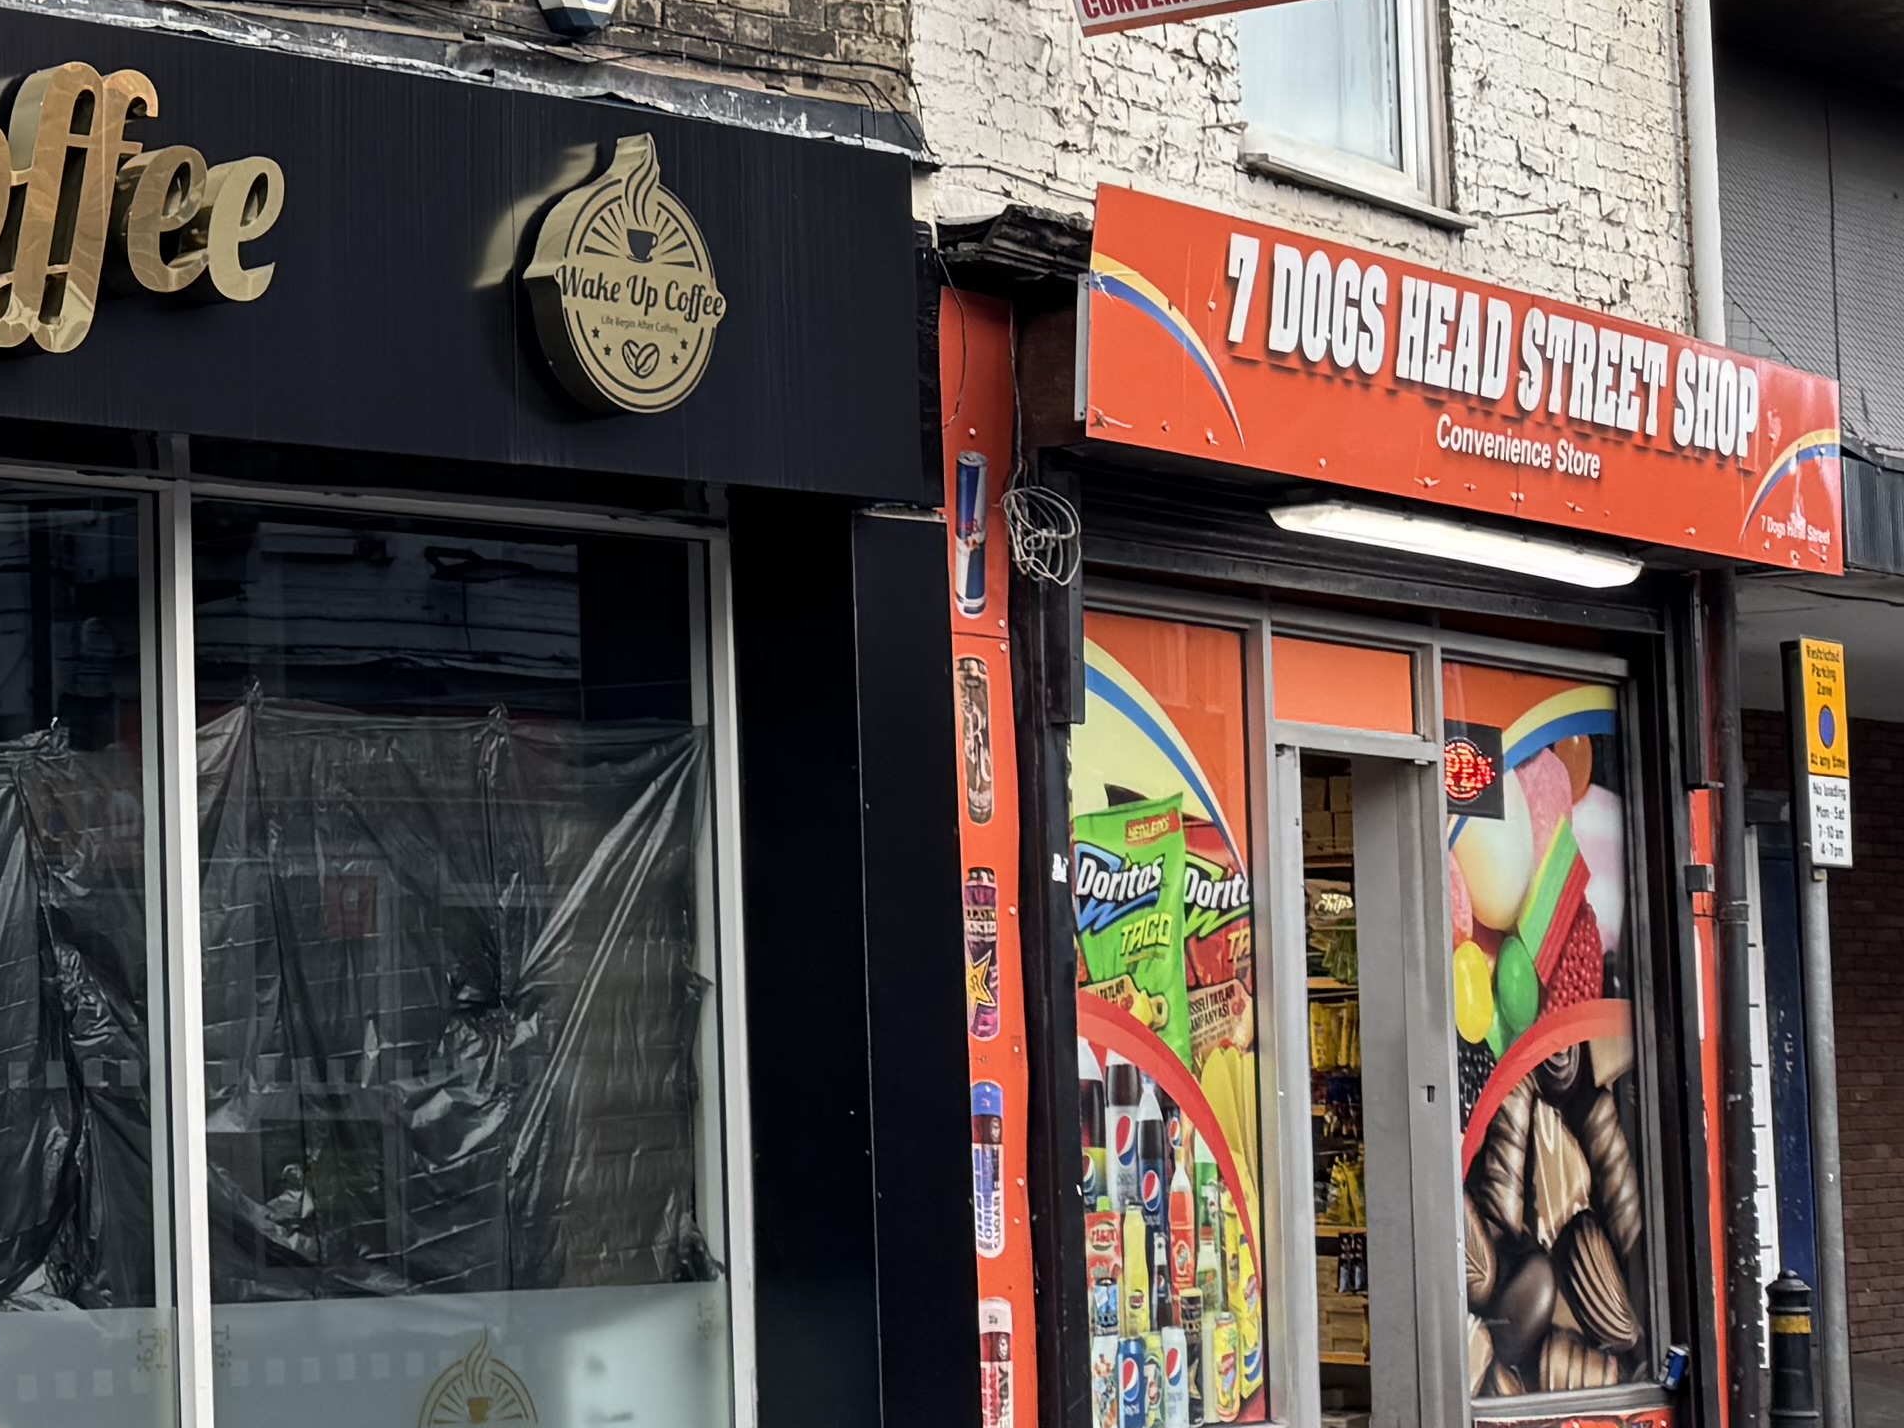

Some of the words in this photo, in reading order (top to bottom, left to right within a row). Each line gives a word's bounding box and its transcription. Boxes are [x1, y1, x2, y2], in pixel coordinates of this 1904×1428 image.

[555, 263, 622, 306] Wake
[627, 275, 659, 317] Up
[664, 280, 724, 323] Coffee
[1228, 232, 1260, 344] 7
[1268, 242, 1388, 375] DOGS
[1396, 274, 1513, 400] HEAD
[1517, 307, 1669, 437] STREET
[1673, 348, 1759, 458] SHOP
[1436, 413, 1552, 470] Convenience
[1556, 437, 1601, 479] Store
[1075, 853, 1166, 902] Doritos
[1120, 913, 1173, 956] TACO
